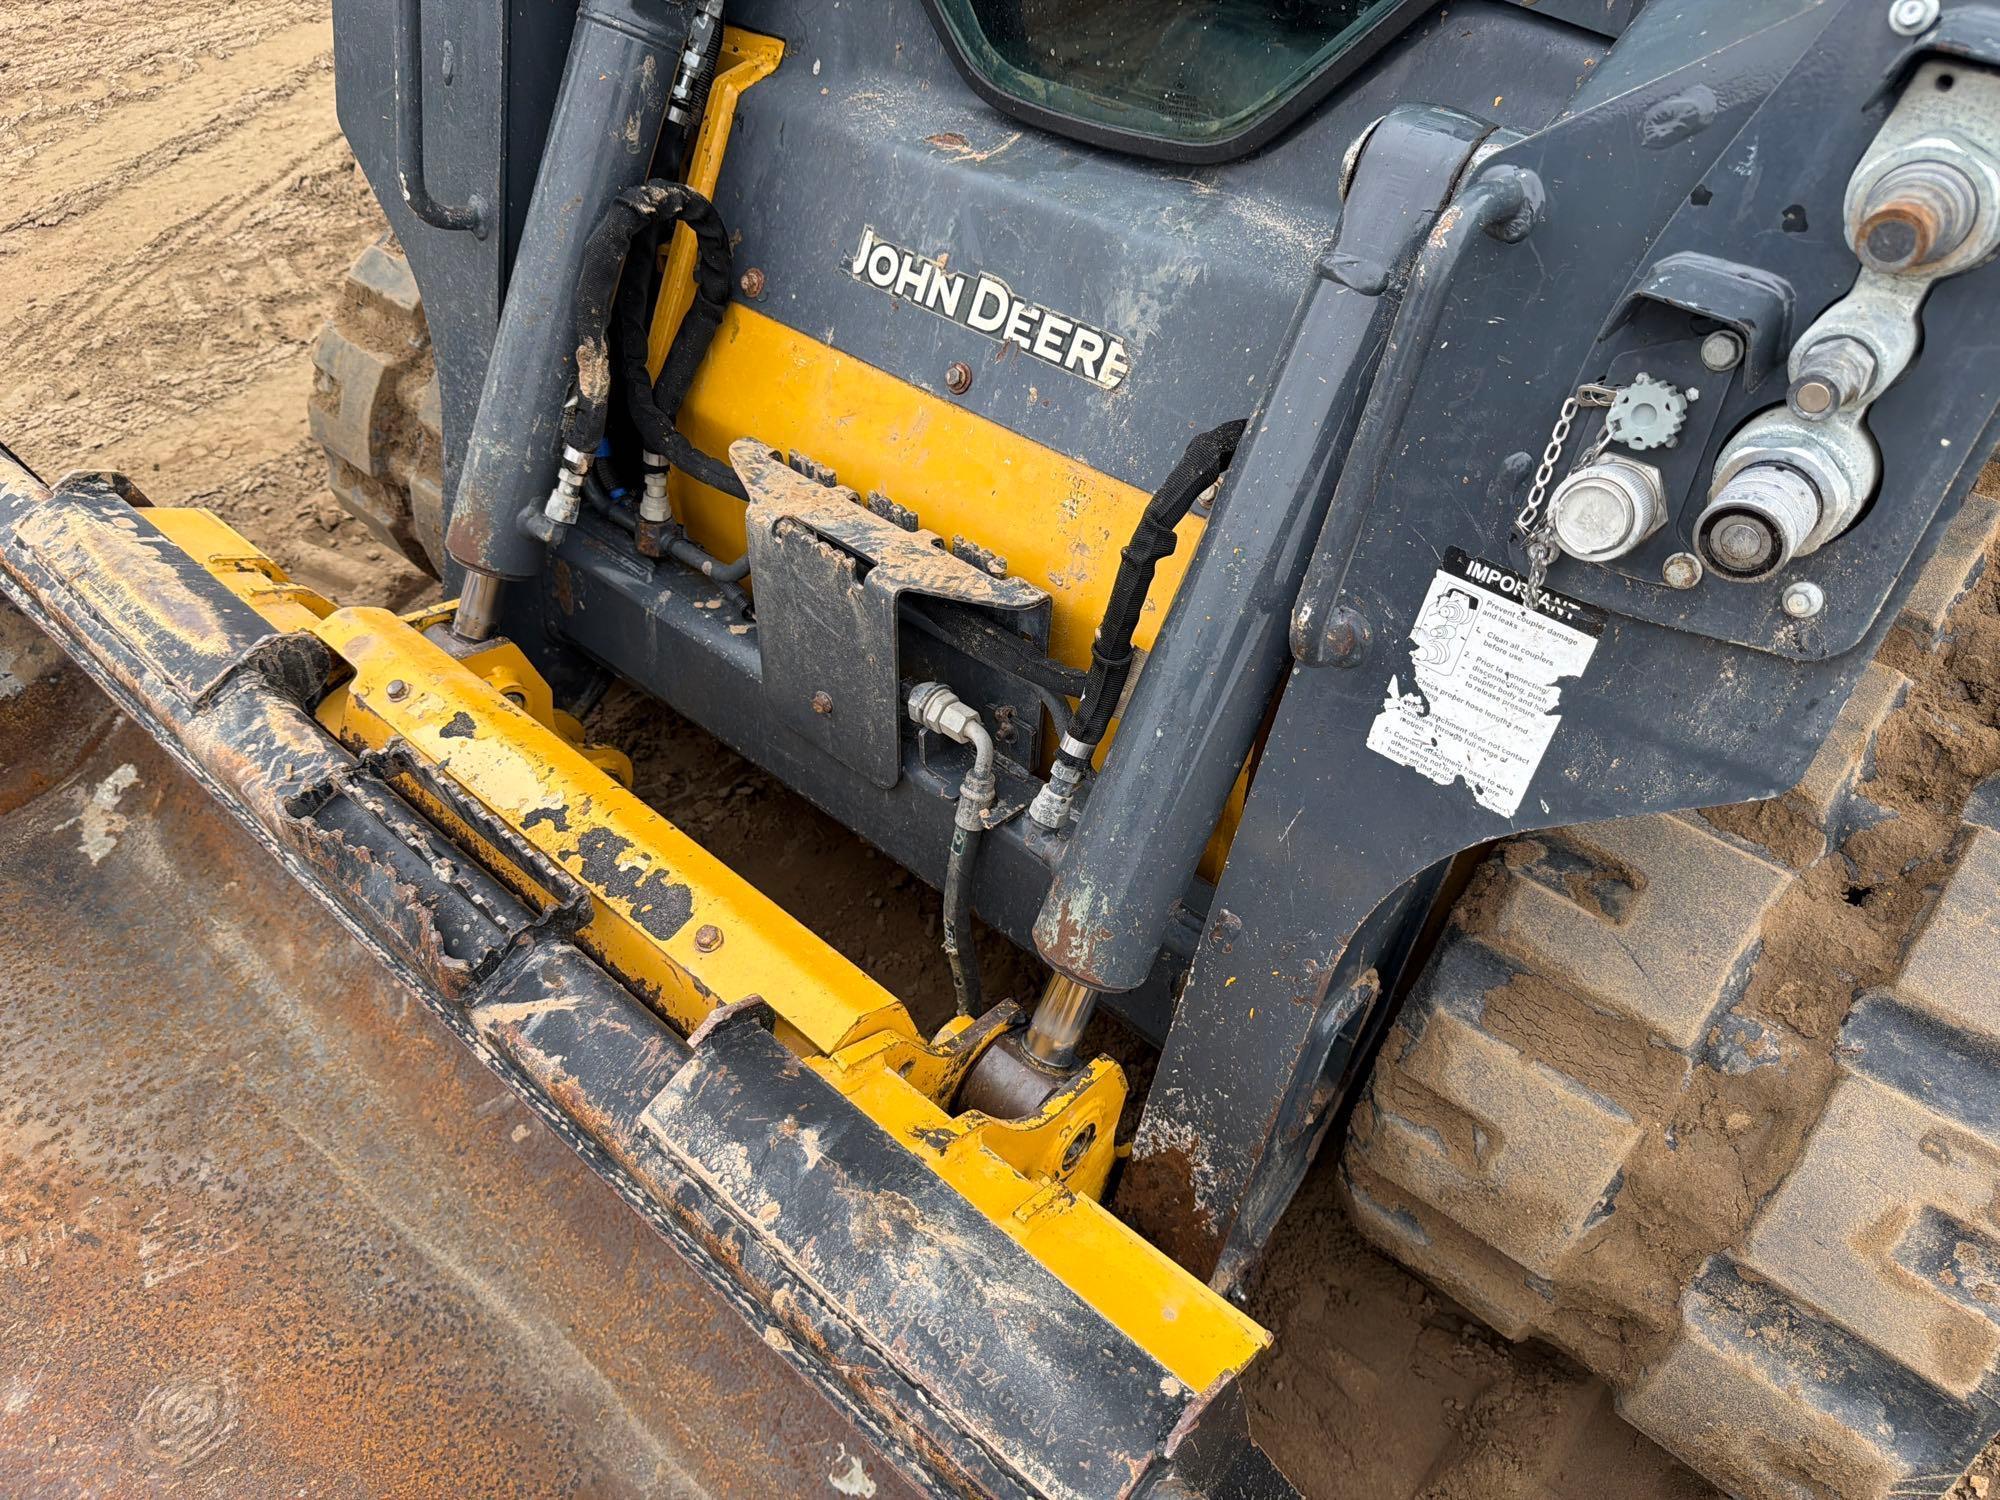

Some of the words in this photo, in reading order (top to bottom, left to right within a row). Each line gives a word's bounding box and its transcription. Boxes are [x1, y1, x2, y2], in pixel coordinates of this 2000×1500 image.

[853, 230, 965, 316] JOHN
[1464, 559, 1581, 622] IMPORANT
[1481, 608, 1497, 620] and
[1485, 599, 1516, 618] Prevent
[1515, 613, 1546, 633] coupler
[1545, 626, 1579, 648] damage
[1474, 655, 1495, 670] Prior
[1494, 664, 1504, 674] to
[1482, 638, 1508, 656] before
[1507, 651, 1525, 664] use.
[1485, 630, 1510, 646] Clean
[1508, 640, 1520, 651] all
[1520, 646, 1555, 668] couplers
[1415, 676, 1440, 692] Check
[1438, 687, 1465, 705] proper
[1464, 699, 1484, 713] hose
[1482, 708, 1513, 728] lengths
[1512, 723, 1529, 735] and
[1463, 680, 1474, 689] to
[1472, 684, 1502, 702] release
[1466, 672, 1497, 691] coupler
[1496, 686, 1517, 701] body
[1516, 695, 1533, 708] and
[1526, 690, 1548, 705] push
[1401, 707, 1434, 727] couplers
[1432, 722, 1464, 743] through
[1463, 737, 1477, 748] full
[1475, 744, 1499, 760] range
[1498, 754, 1508, 764] of
[1466, 730, 1487, 744] does
[1486, 739, 1501, 751] not
[1499, 746, 1530, 765] contact
[1389, 738, 1409, 752] other
[1408, 748, 1430, 762] when
[1429, 758, 1443, 769] not
[1442, 764, 1450, 772] in
[1392, 730, 1424, 749] Connect
[1486, 777, 1496, 786] to
